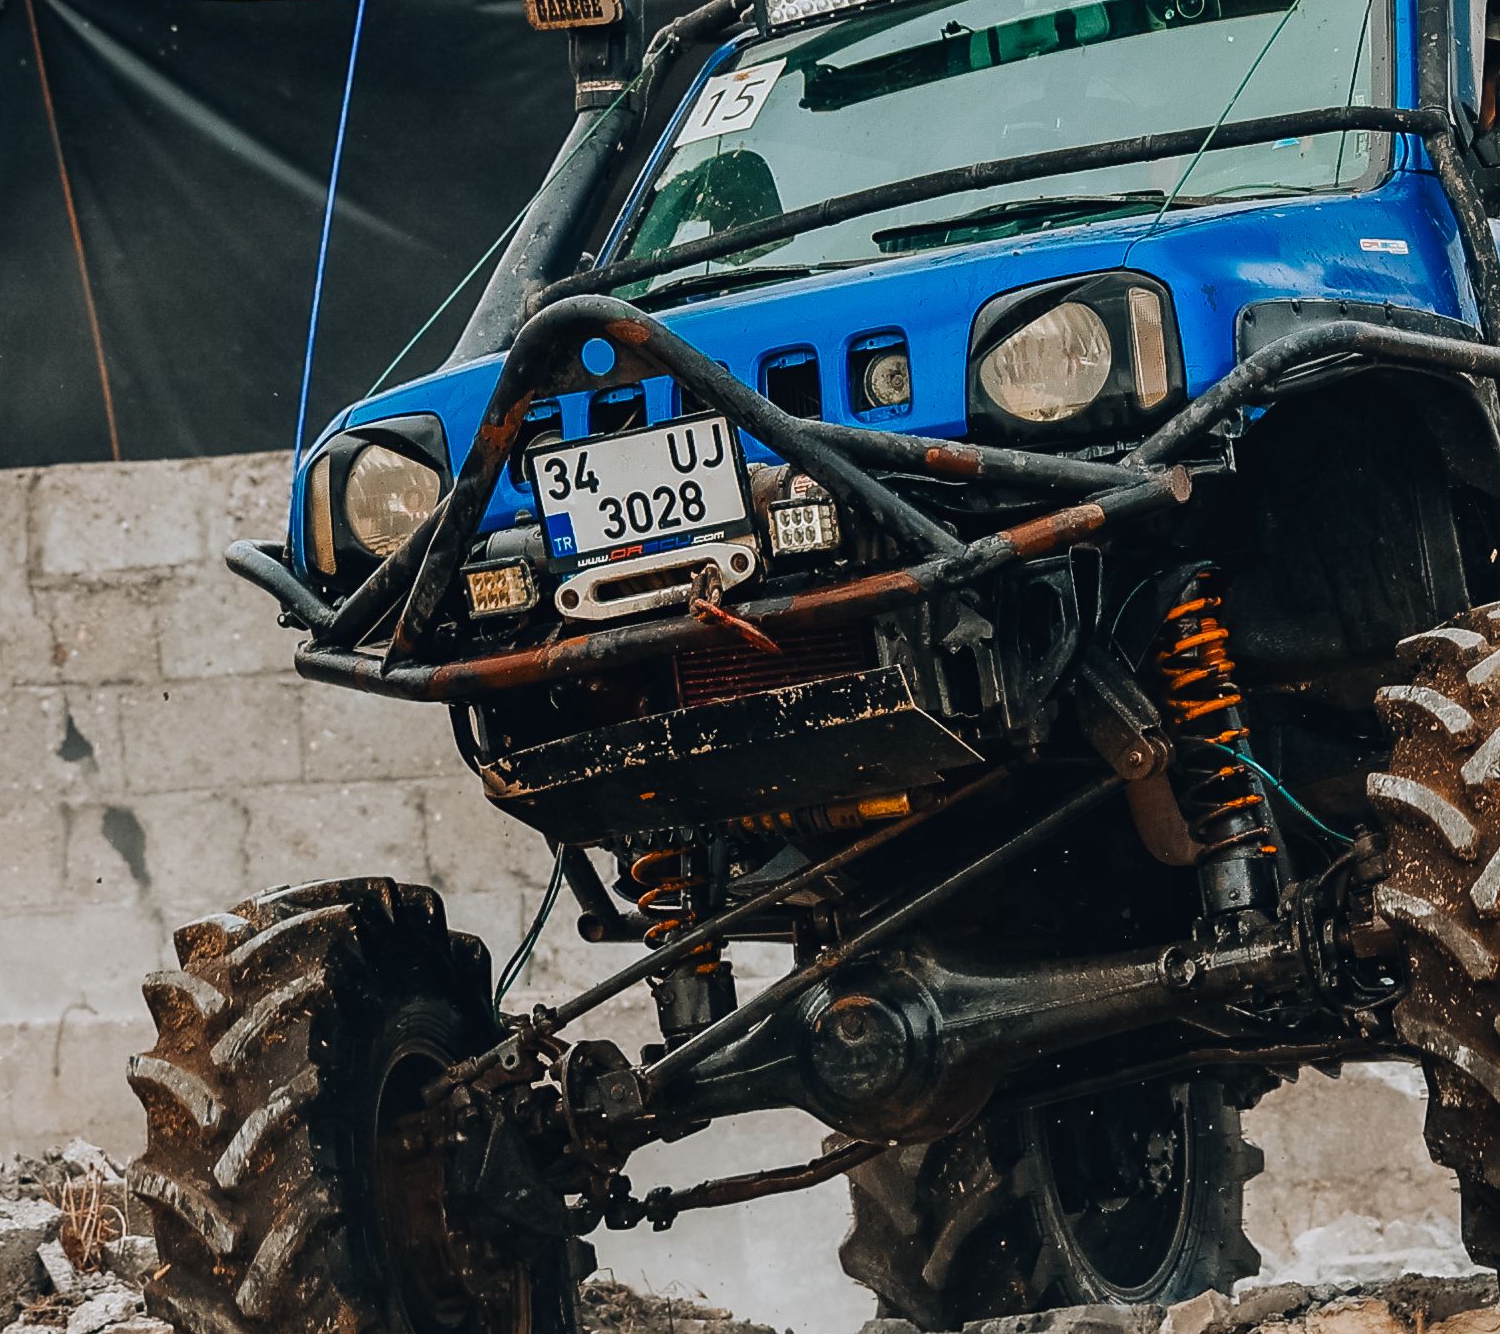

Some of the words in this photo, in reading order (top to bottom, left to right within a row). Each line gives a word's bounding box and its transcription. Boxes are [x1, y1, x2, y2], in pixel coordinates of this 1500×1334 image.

[700, 78, 767, 128] 15
[543, 450, 601, 502] 34
[666, 423, 725, 474] UJ
[598, 479, 707, 541] 3028
[553, 535, 575, 552] TR
